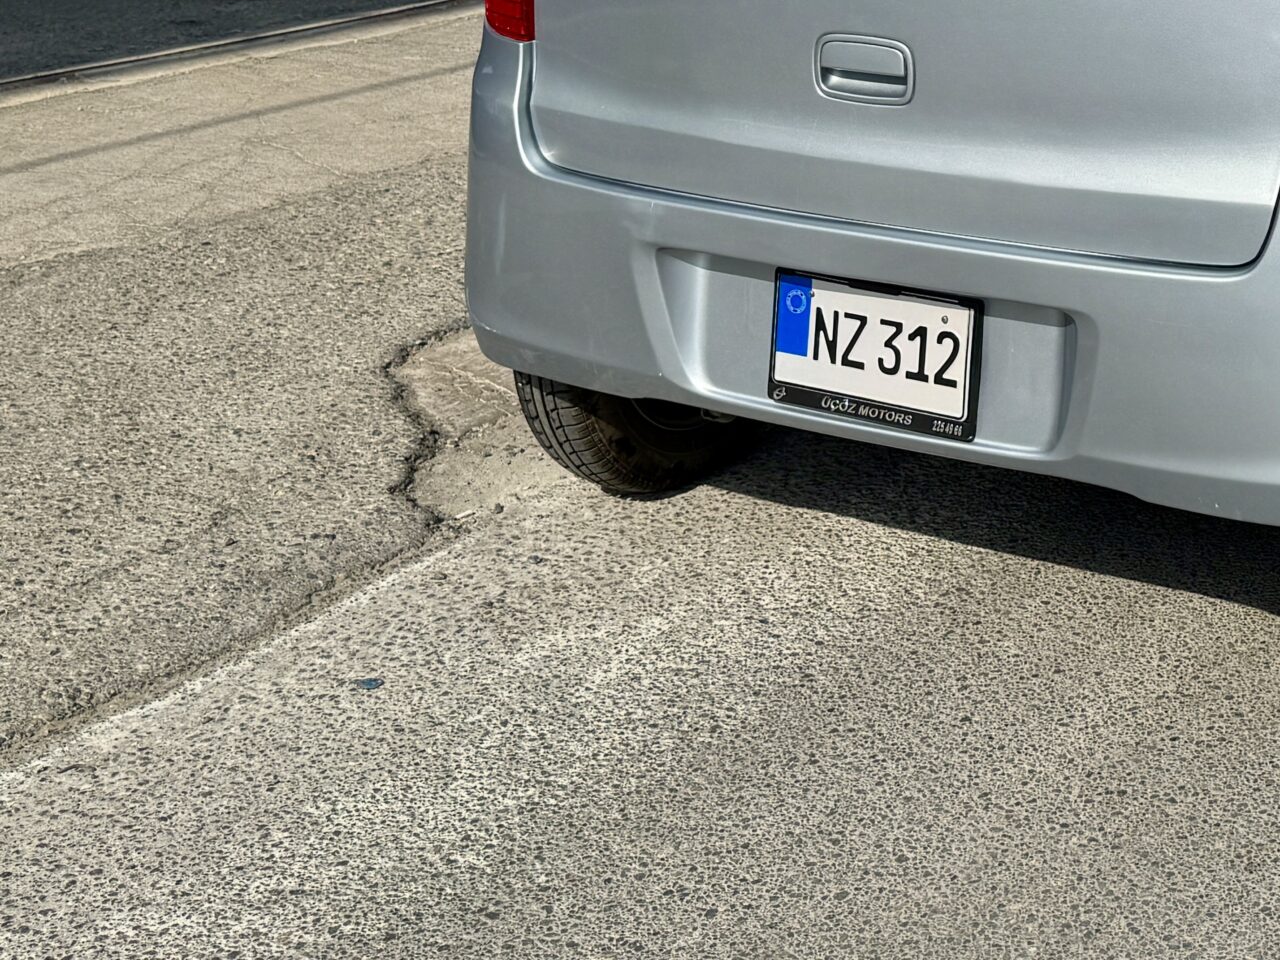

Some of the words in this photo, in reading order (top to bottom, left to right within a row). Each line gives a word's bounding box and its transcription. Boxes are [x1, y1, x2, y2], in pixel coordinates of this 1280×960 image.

[812, 306, 868, 370] NZ
[877, 319, 961, 389] 312
[858, 404, 913, 425] MOTORS
